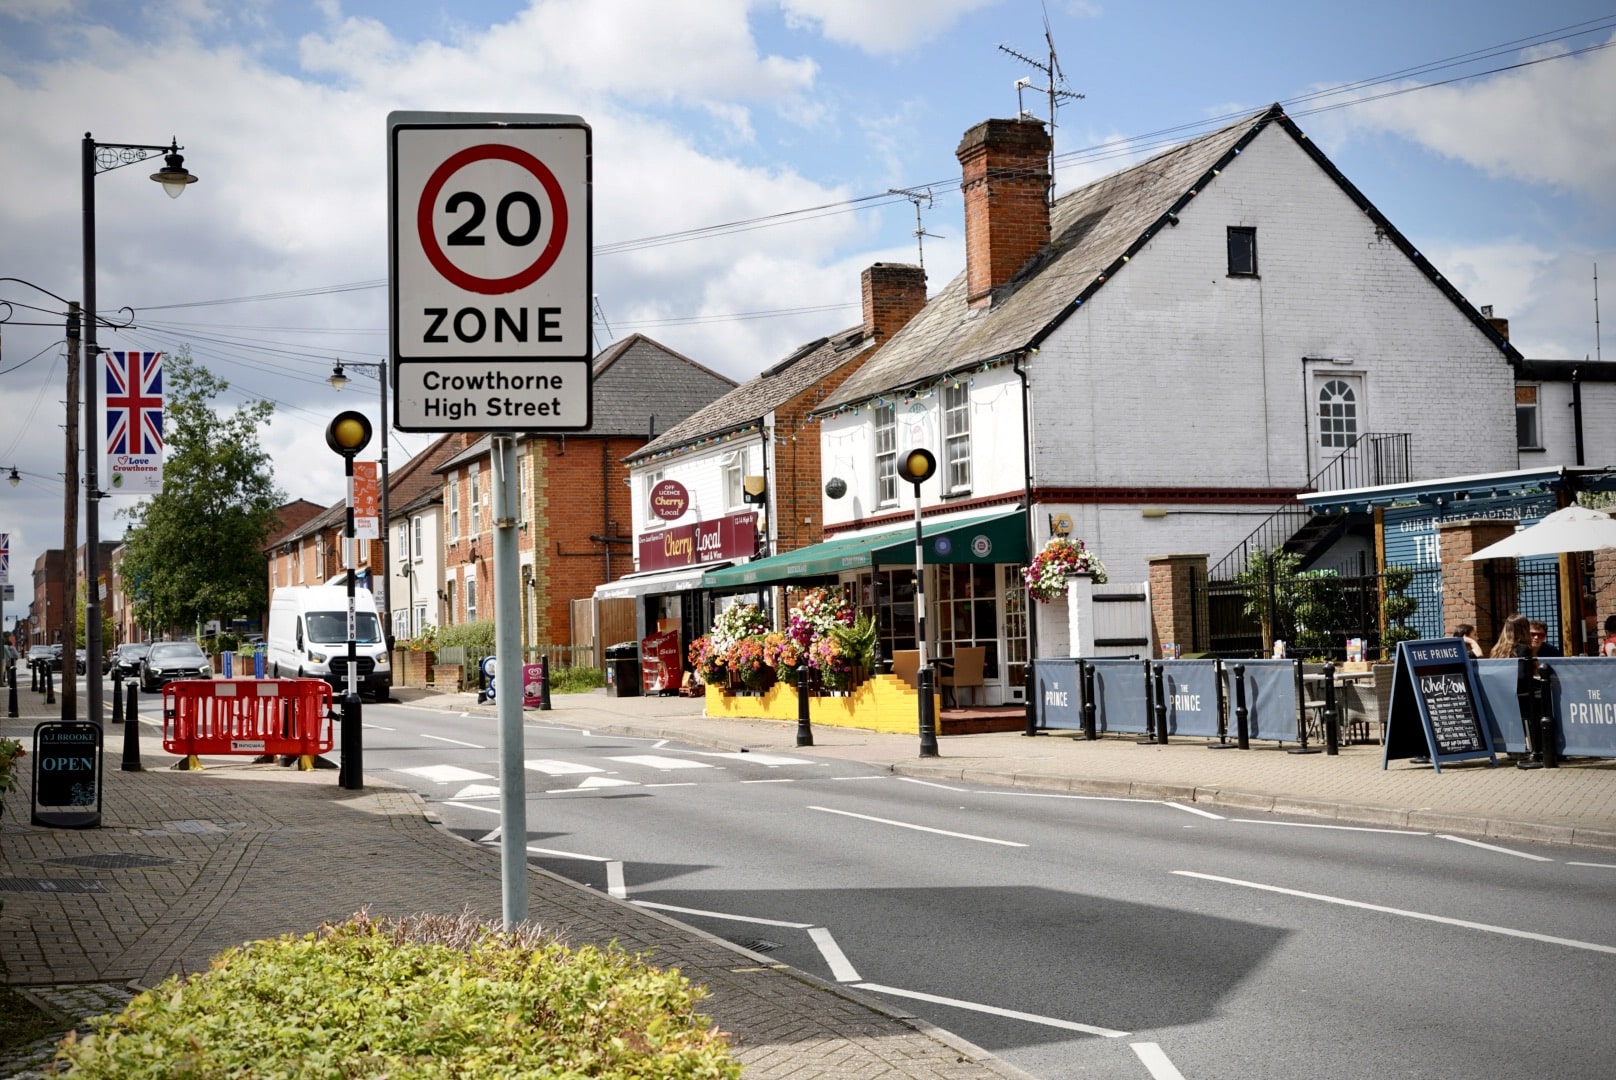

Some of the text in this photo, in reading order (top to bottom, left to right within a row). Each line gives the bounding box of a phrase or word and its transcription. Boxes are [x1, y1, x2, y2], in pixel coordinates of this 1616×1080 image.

[445, 191, 541, 246] 20
[423, 307, 562, 343] ZONE
[423, 371, 563, 390] Crowthorne
[424, 397, 561, 419] High Street
[112, 464, 158, 472] Crowthorne
[129, 457, 149, 465] Love
[655, 496, 684, 509] Cherry
[660, 508, 679, 516] Local
[1400, 518, 1424, 533] OUR
[1525, 505, 1539, 520] AT
[664, 521, 722, 563] Cherry Local
[1413, 533, 1442, 564] THE
[1412, 648, 1459, 660] THE PRINCE
[1180, 684, 1189, 693] THE
[1452, 682, 1467, 693] ON
[1587, 689, 1601, 700] THE
[1046, 691, 1068, 708] PRINCE
[1170, 694, 1201, 711] PRINCE
[57, 733, 95, 741] BROOKE
[42, 757, 93, 771] OPEN
